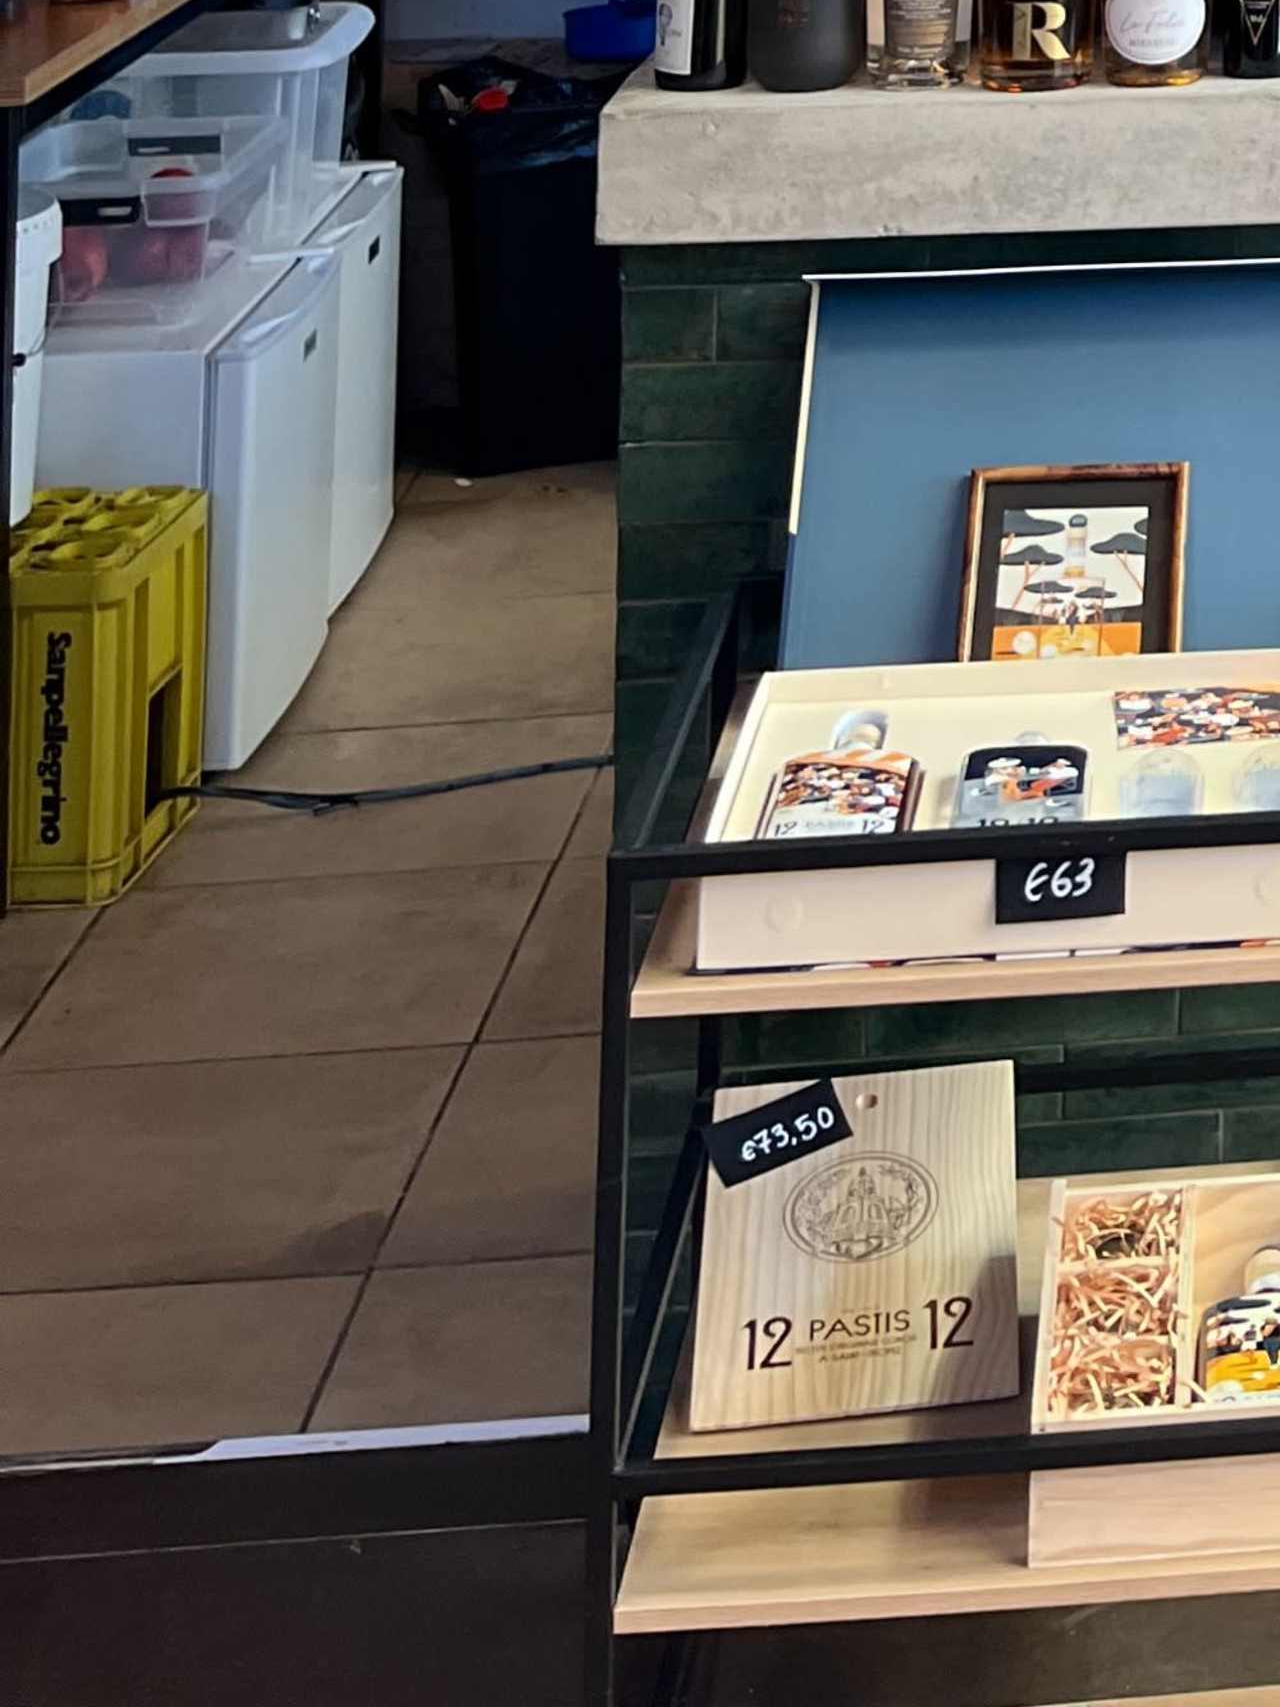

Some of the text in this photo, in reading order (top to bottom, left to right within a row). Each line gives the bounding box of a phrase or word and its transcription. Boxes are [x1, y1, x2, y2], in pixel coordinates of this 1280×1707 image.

[1012, 0, 1071, 62] R
[37, 630, 73, 846] Sanpellegrino
[1023, 856, 1095, 902] €63
[742, 1295, 976, 1371] 12 PASTIS 12
